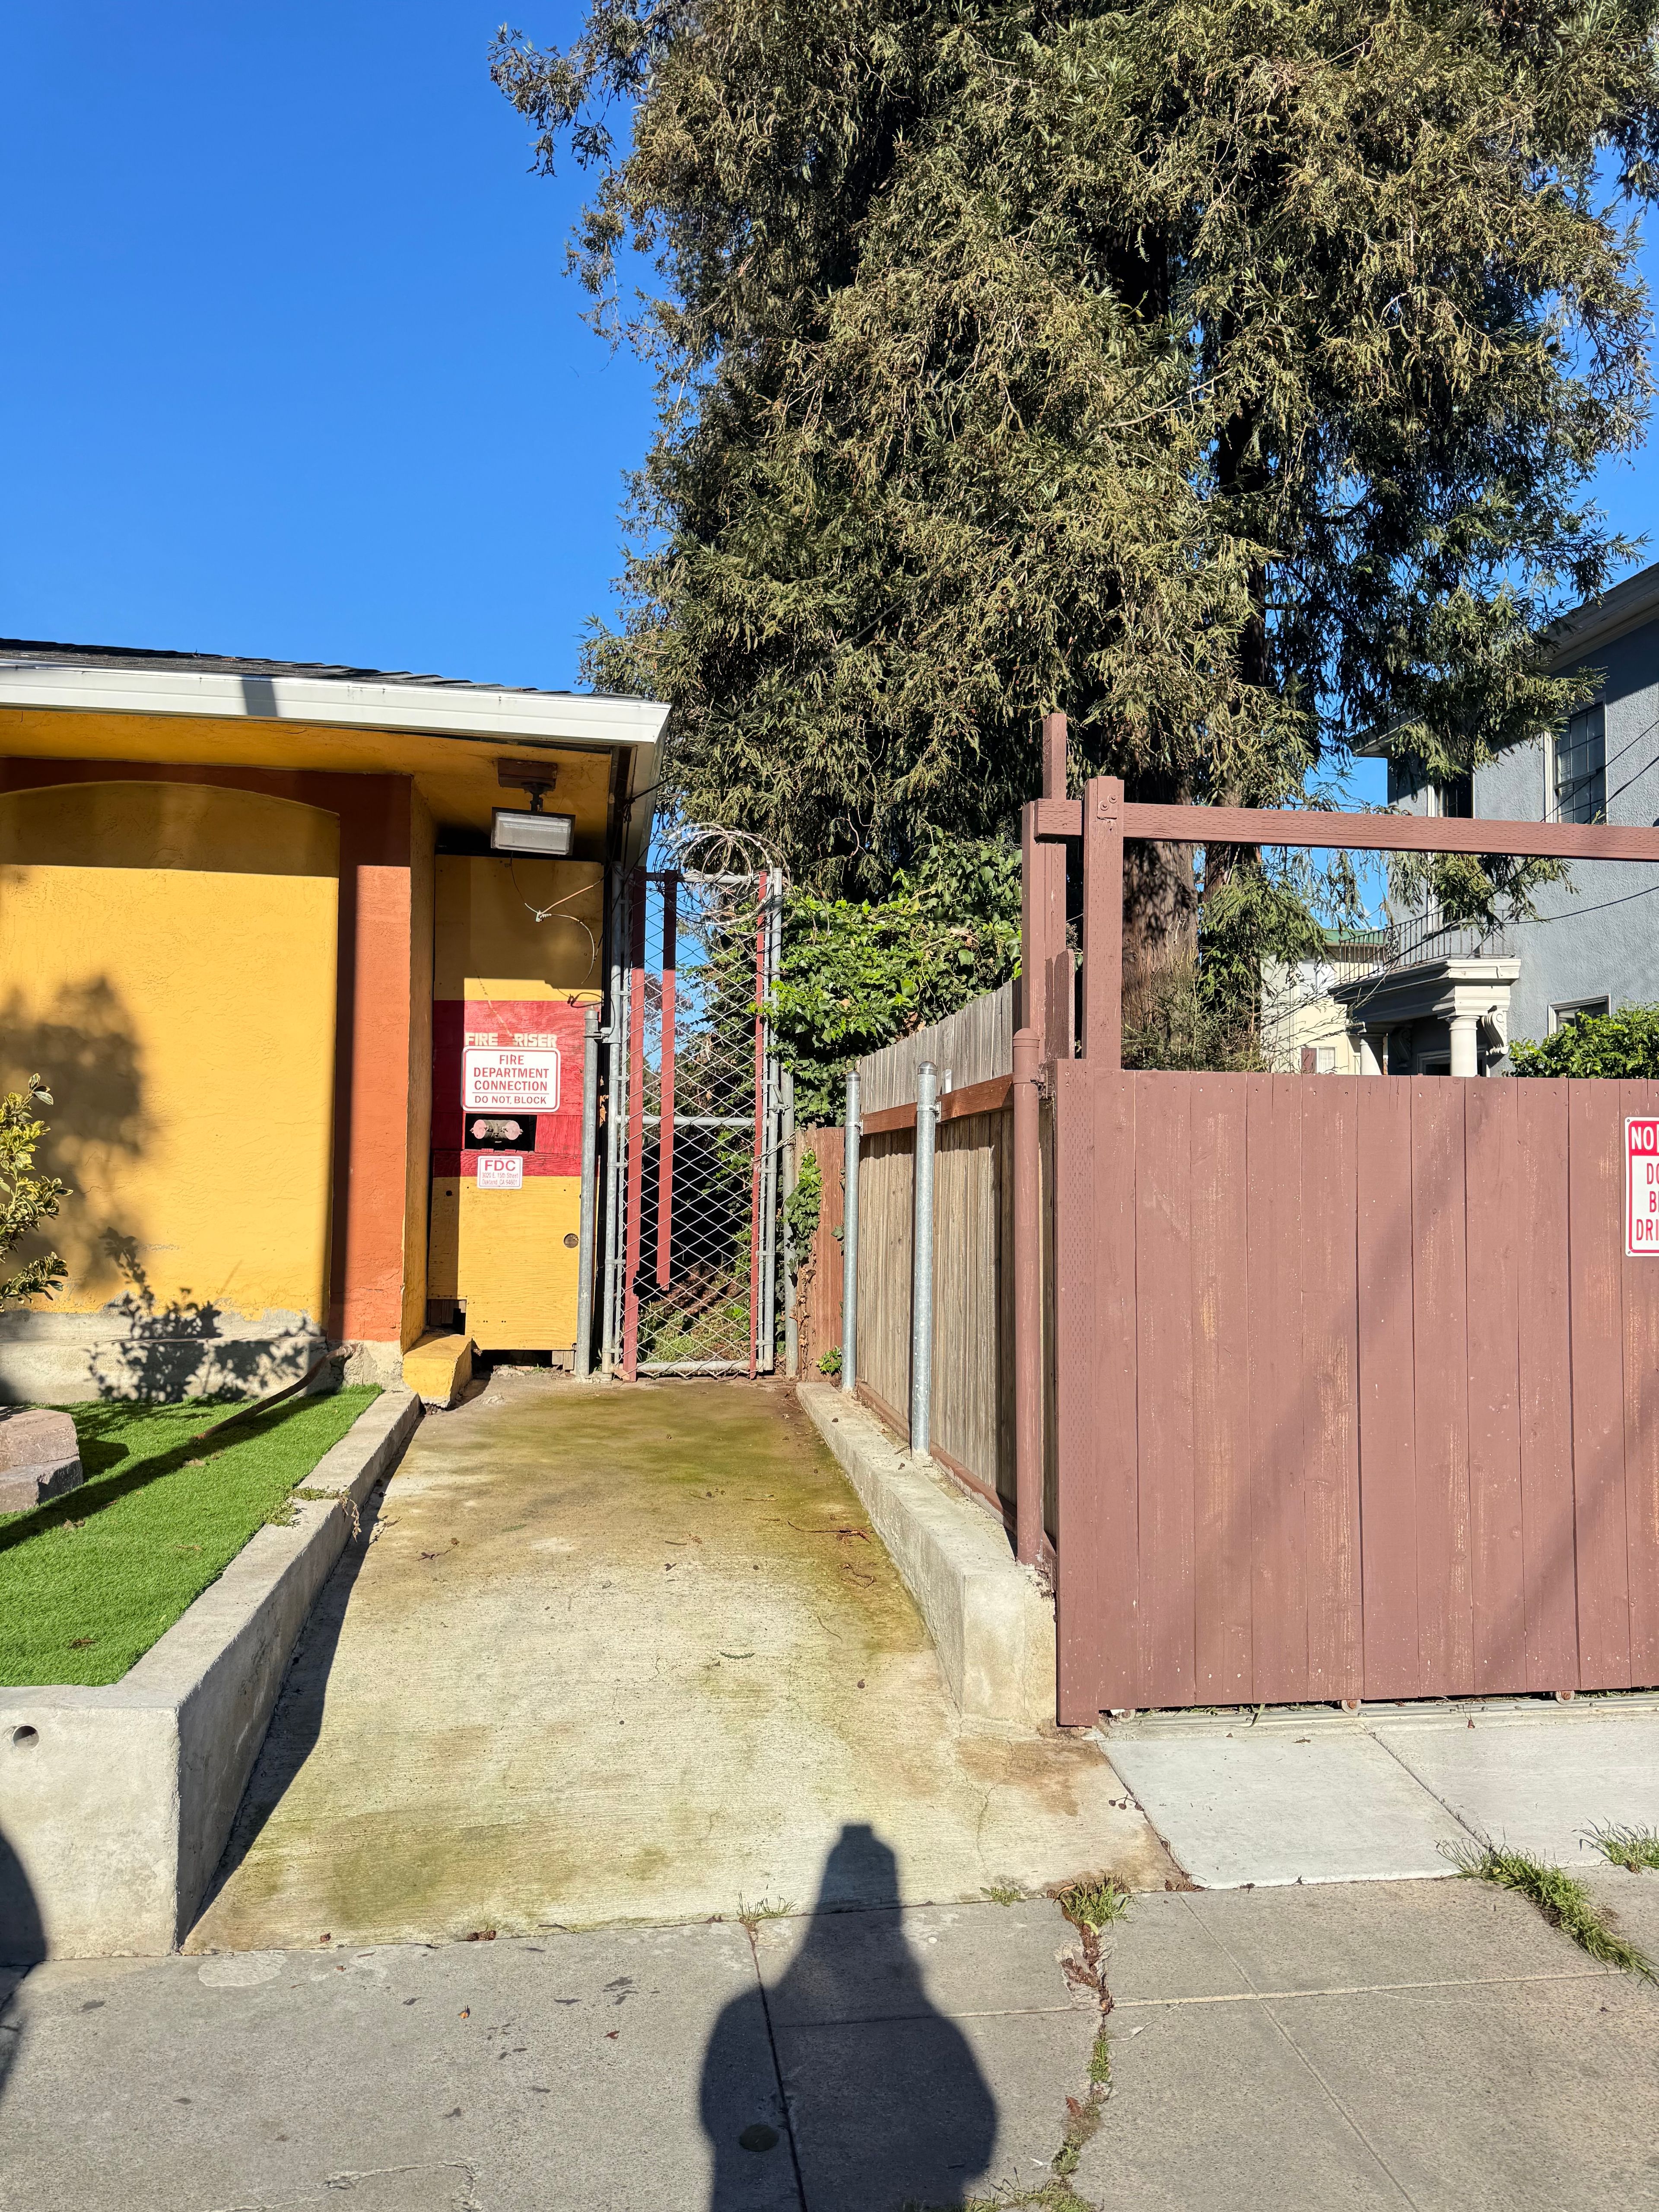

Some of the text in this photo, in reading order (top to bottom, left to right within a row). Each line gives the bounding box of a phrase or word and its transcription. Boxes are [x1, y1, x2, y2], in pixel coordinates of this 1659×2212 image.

[465, 1033, 557, 1047] FIRE RISER
[499, 1055, 524, 1065] FIRE
[474, 1067, 549, 1078] DEPARTMENT
[474, 1081, 547, 1091] CONNECTION
[1631, 1126, 1654, 1150] NO
[485, 1160, 515, 1171] FDC
